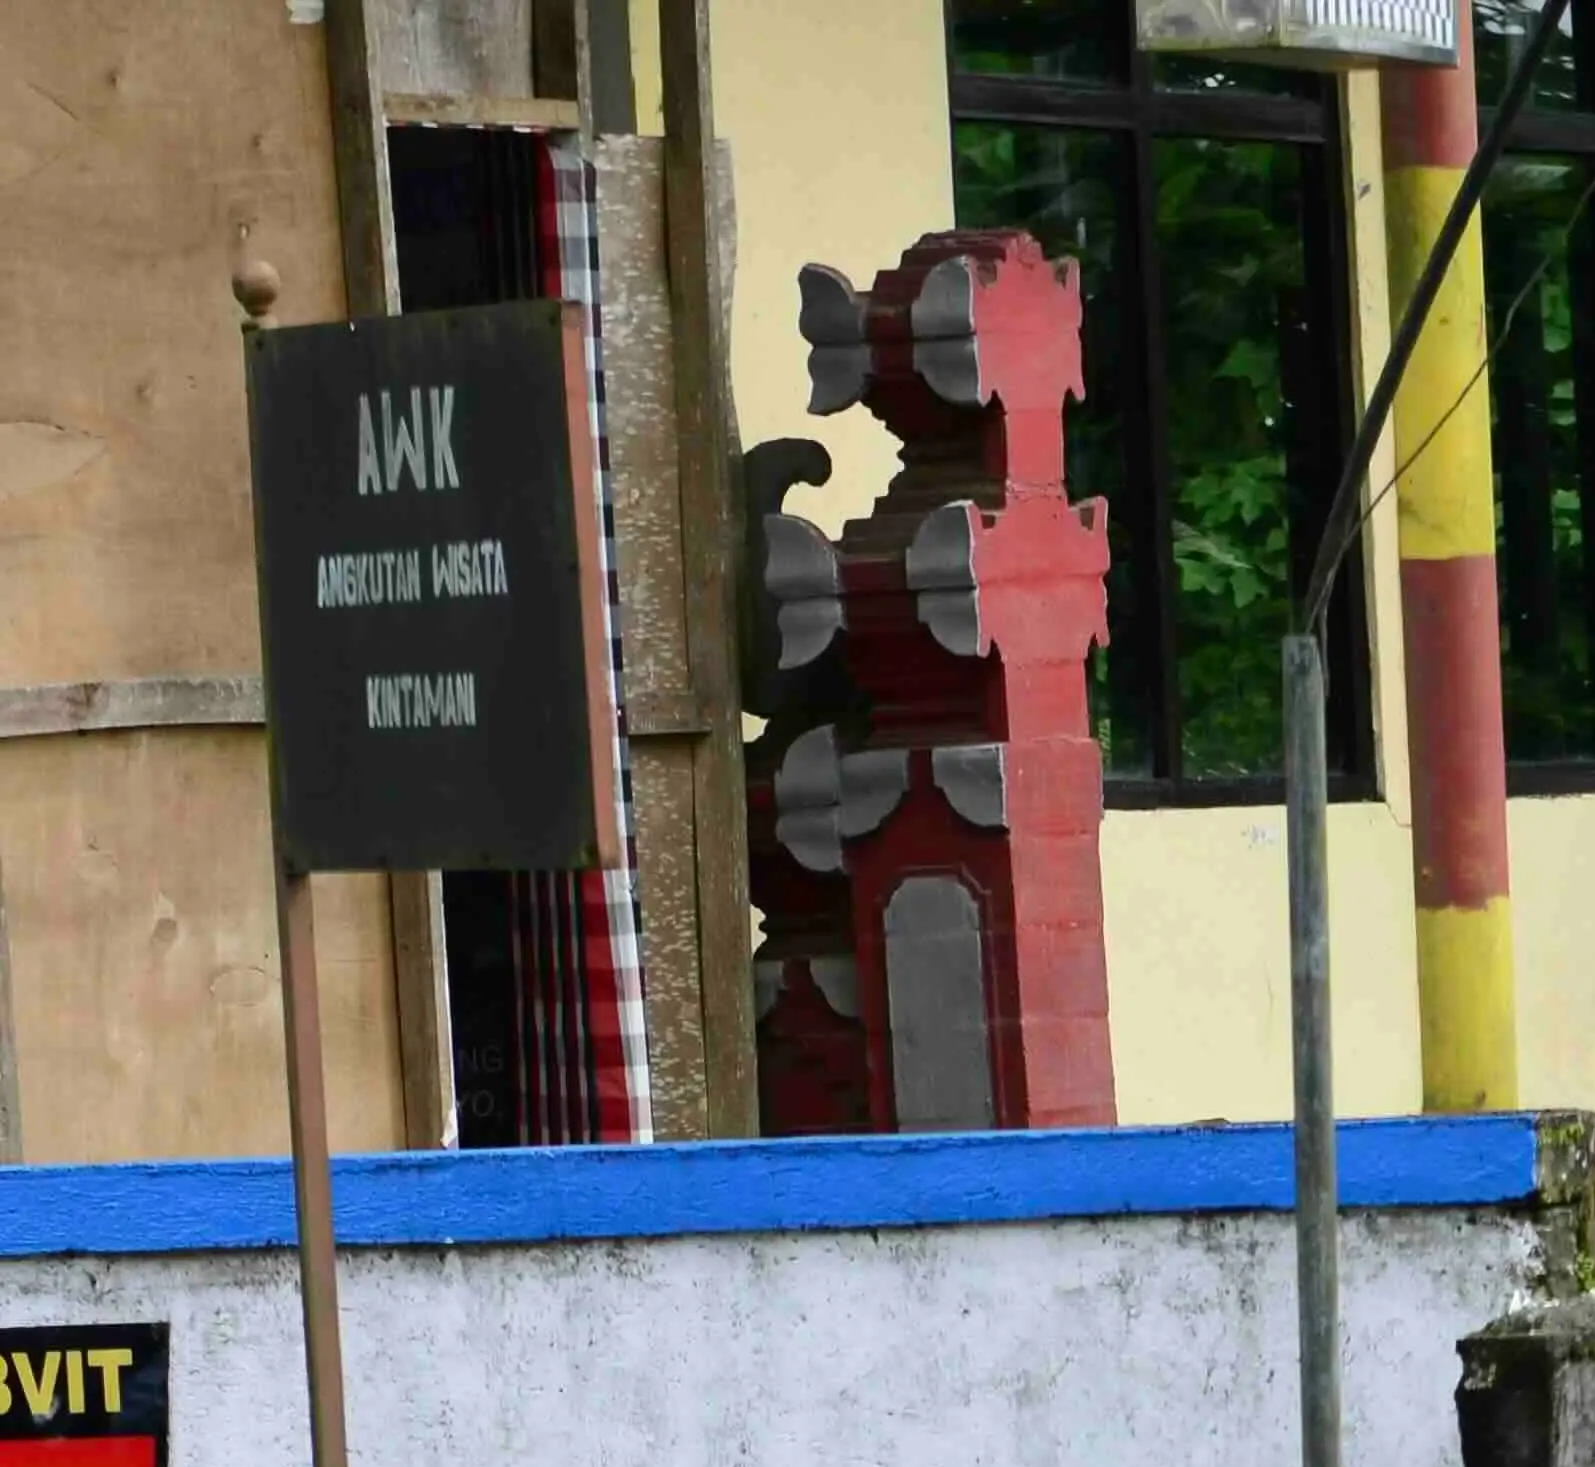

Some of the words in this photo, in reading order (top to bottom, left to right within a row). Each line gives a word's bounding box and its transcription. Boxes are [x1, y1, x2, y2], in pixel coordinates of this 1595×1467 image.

[357, 385, 460, 496] AWK
[317, 547, 422, 609] ANGKUTAN
[431, 538, 509, 599] WISATA
[366, 672, 477, 729] KINTAMANI
